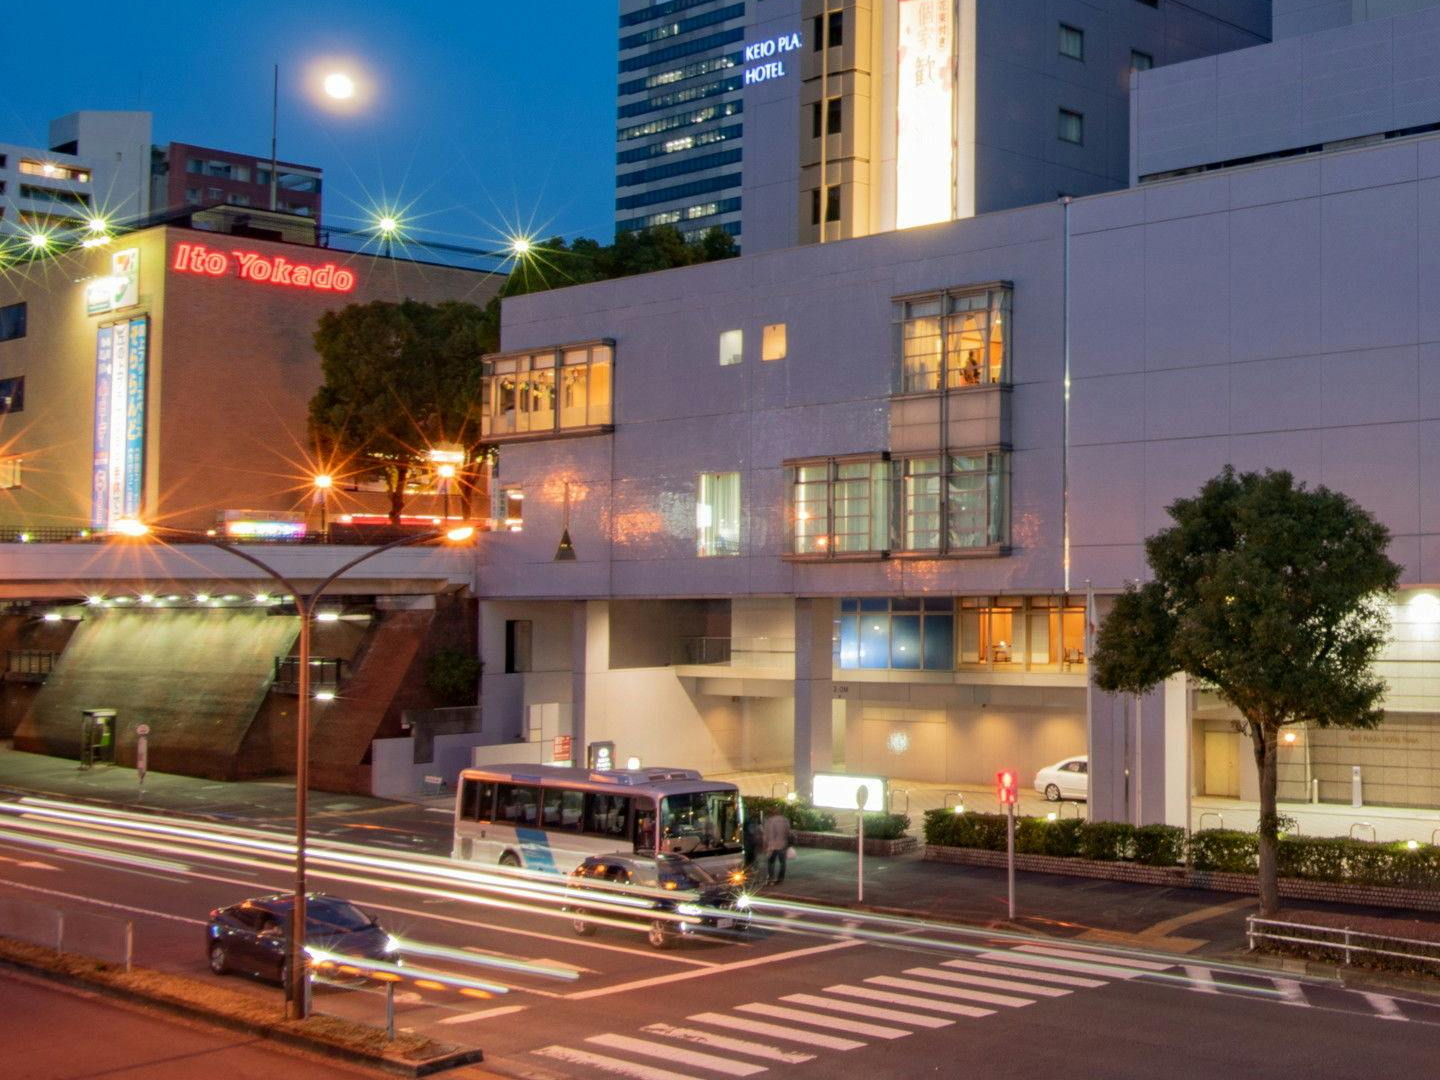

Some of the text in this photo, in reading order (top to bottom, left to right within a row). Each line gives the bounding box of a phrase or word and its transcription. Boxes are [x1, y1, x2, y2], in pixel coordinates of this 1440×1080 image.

[745, 32, 802, 61] KEIO PLA
[745, 61, 786, 85] HOTEL
[174, 243, 354, 291] Ito Yokado
